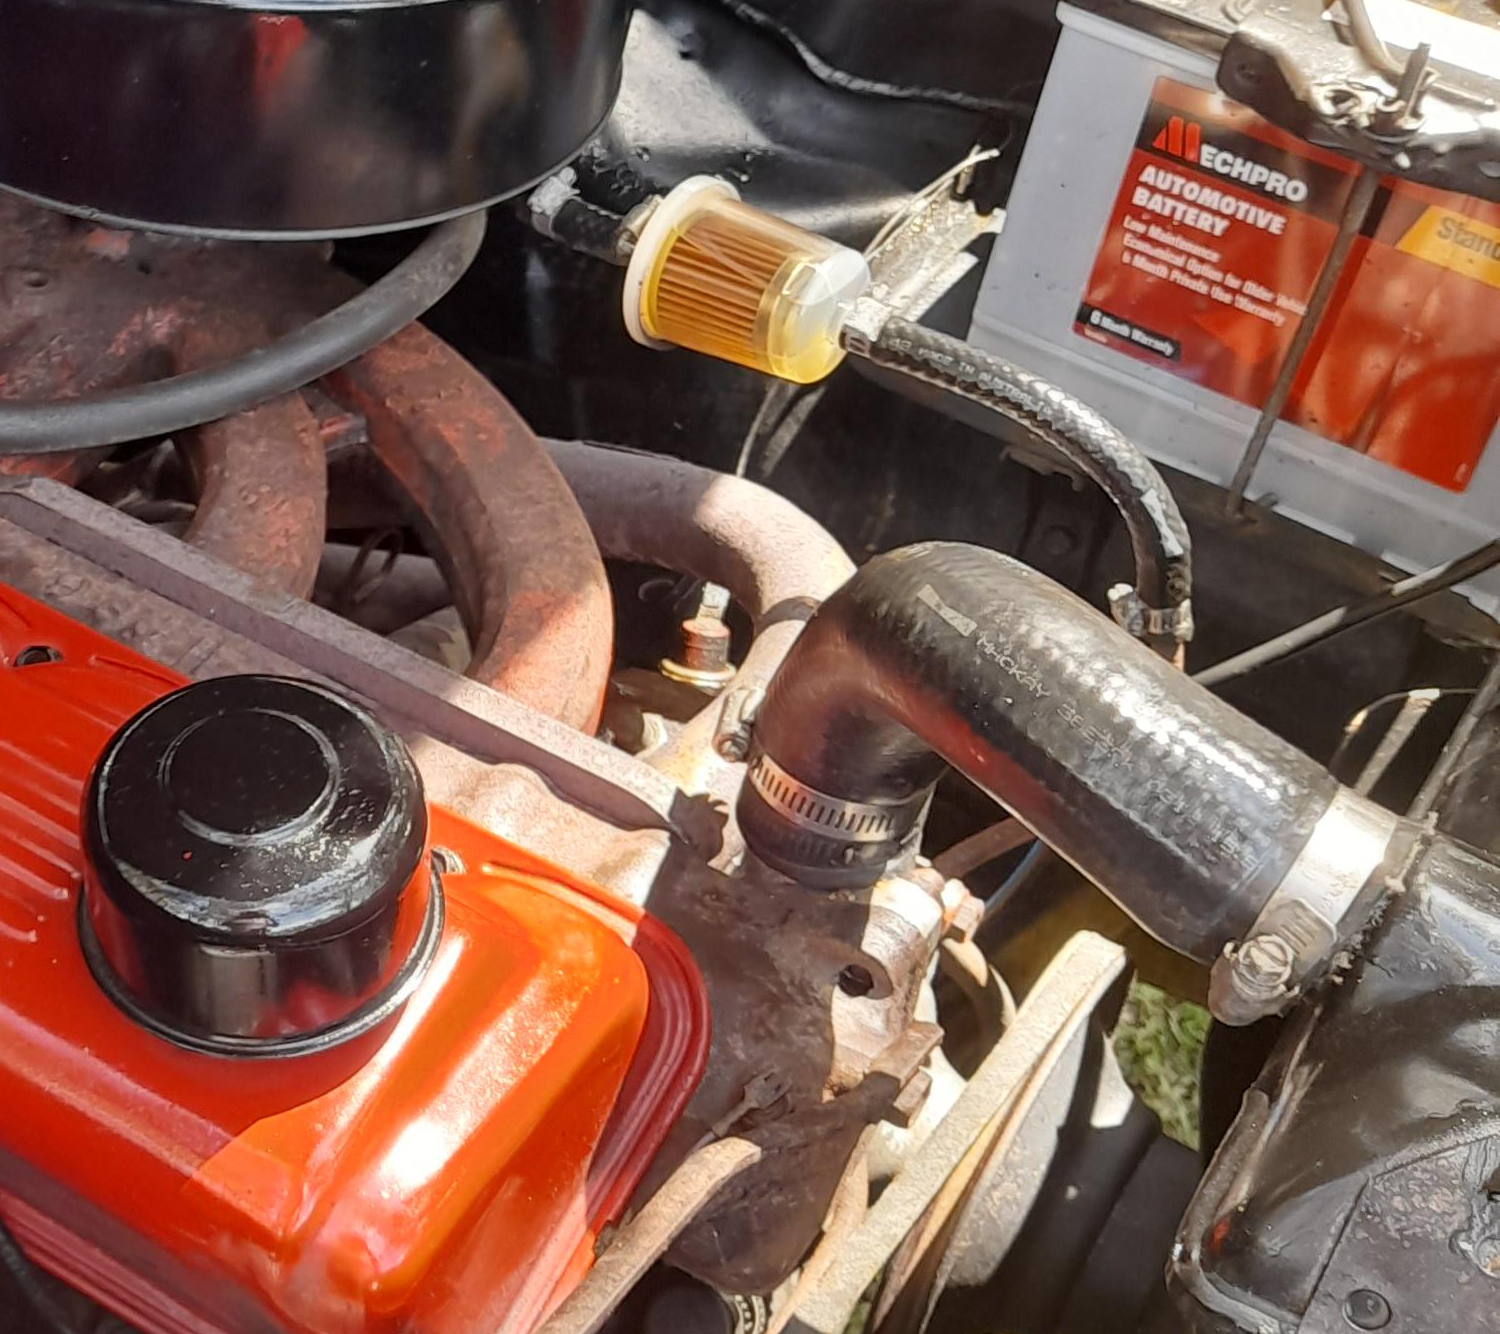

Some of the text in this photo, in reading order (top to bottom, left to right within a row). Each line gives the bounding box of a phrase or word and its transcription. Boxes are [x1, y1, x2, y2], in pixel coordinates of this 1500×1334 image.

[1152, 115, 1308, 204] MECHPRO
[1131, 185, 1230, 238] BATTERY
[1139, 163, 1287, 236] AUTOMOTIVE
[1145, 223, 1222, 264] Maintenance
[1130, 254, 1170, 279] Month
[1168, 269, 1210, 295] Private
[1231, 295, 1286, 328] Warranty
[1088, 308, 1102, 325] 6
[1099, 315, 1132, 337] Month
[1128, 327, 1175, 357] Warranty
[957, 361, 975, 377] IN
[978, 371, 1053, 416] AUSTRALIA
